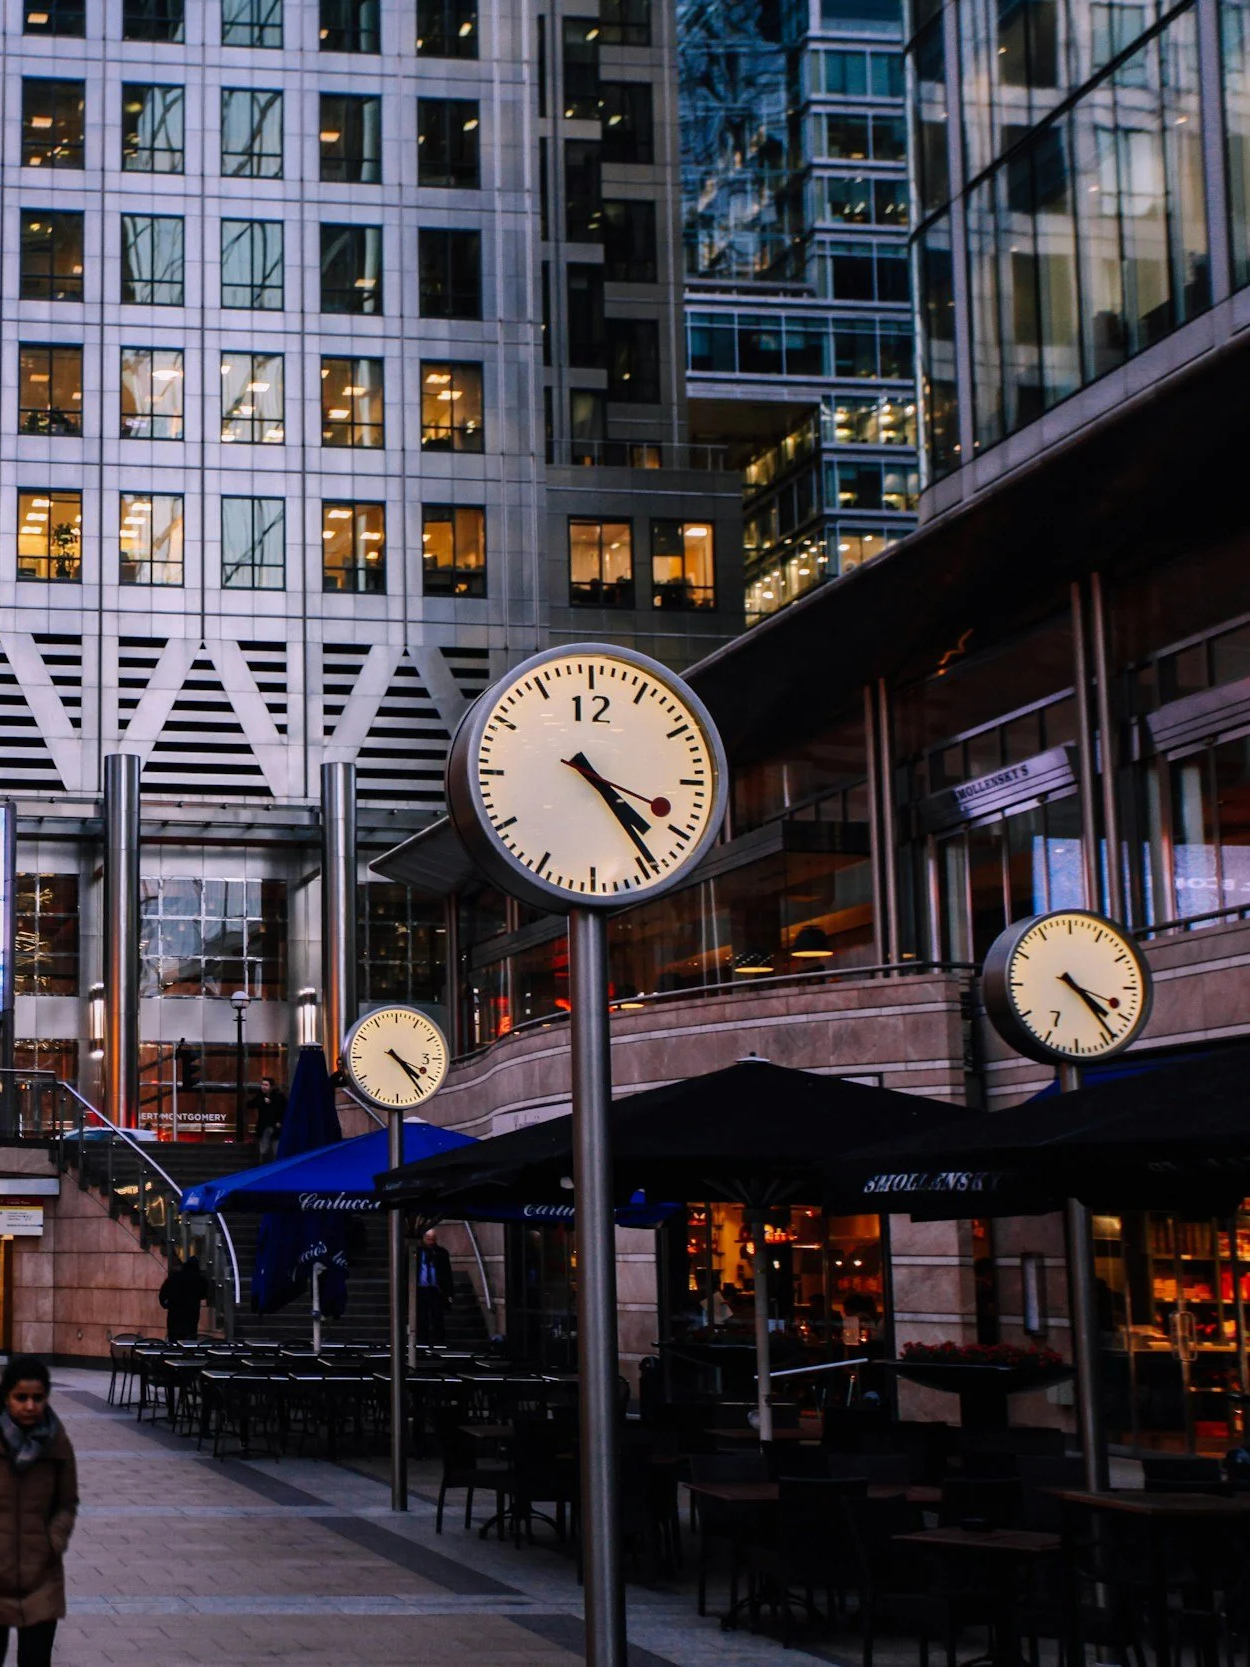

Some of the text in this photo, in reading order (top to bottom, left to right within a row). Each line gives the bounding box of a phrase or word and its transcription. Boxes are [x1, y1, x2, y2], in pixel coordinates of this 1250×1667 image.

[571, 695, 611, 724] 12
[956, 764, 1029, 799] MOLLENSKY'S
[1049, 1010, 1061, 1027] 7
[421, 1053, 430, 1065] 3
